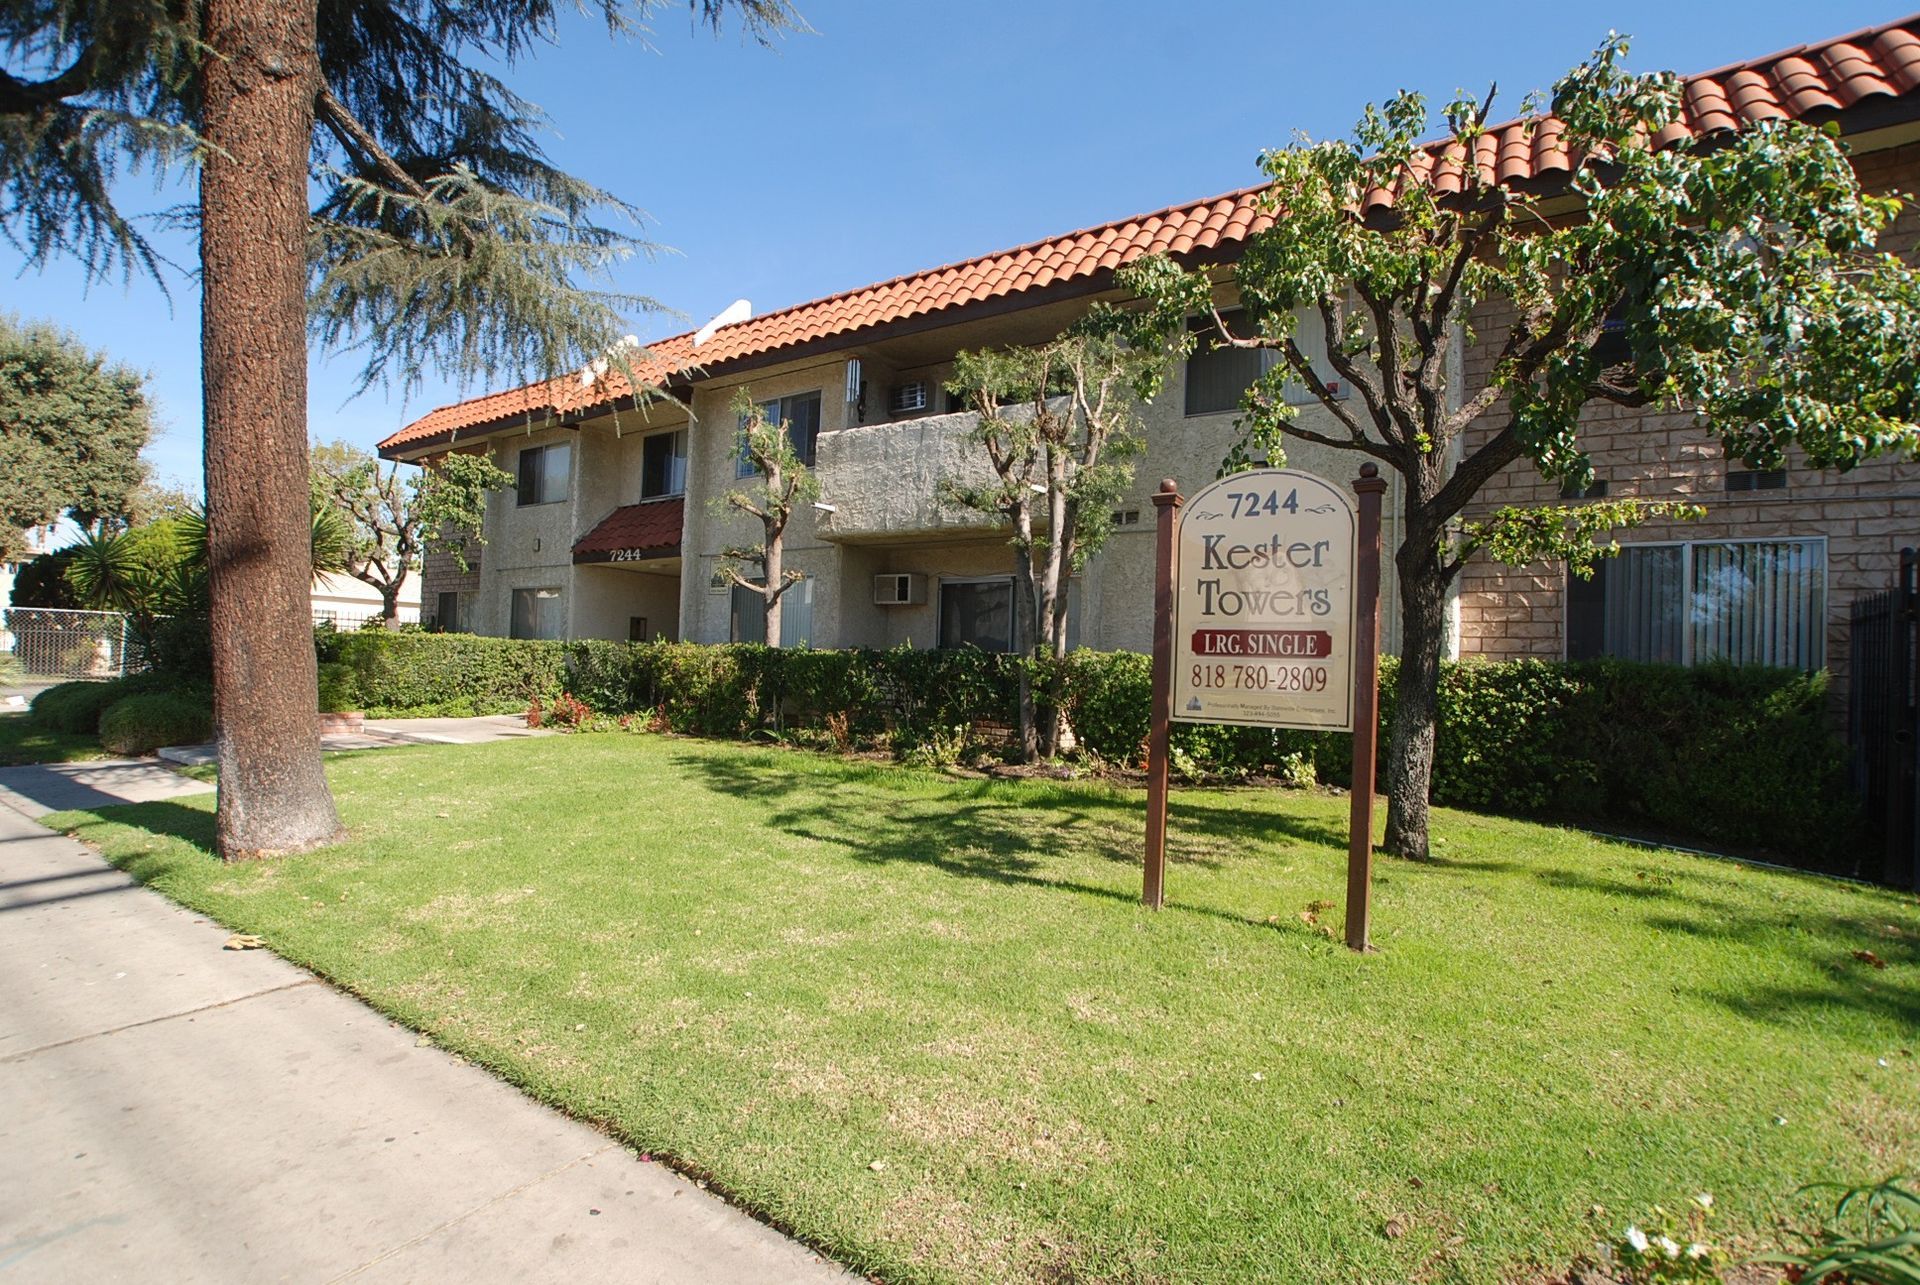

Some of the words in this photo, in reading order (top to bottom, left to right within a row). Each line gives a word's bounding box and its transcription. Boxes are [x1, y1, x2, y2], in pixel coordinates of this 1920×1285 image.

[1227, 489, 1299, 519] 7244
[609, 548, 641, 562] 7244
[1201, 534, 1330, 570] Kester
[1197, 578, 1332, 616] Towers
[1204, 633, 1243, 654] LRG.
[1247, 634, 1317, 656] SINGLE
[1191, 664, 1225, 688] 818
[1233, 665, 1327, 691] 780-2809
